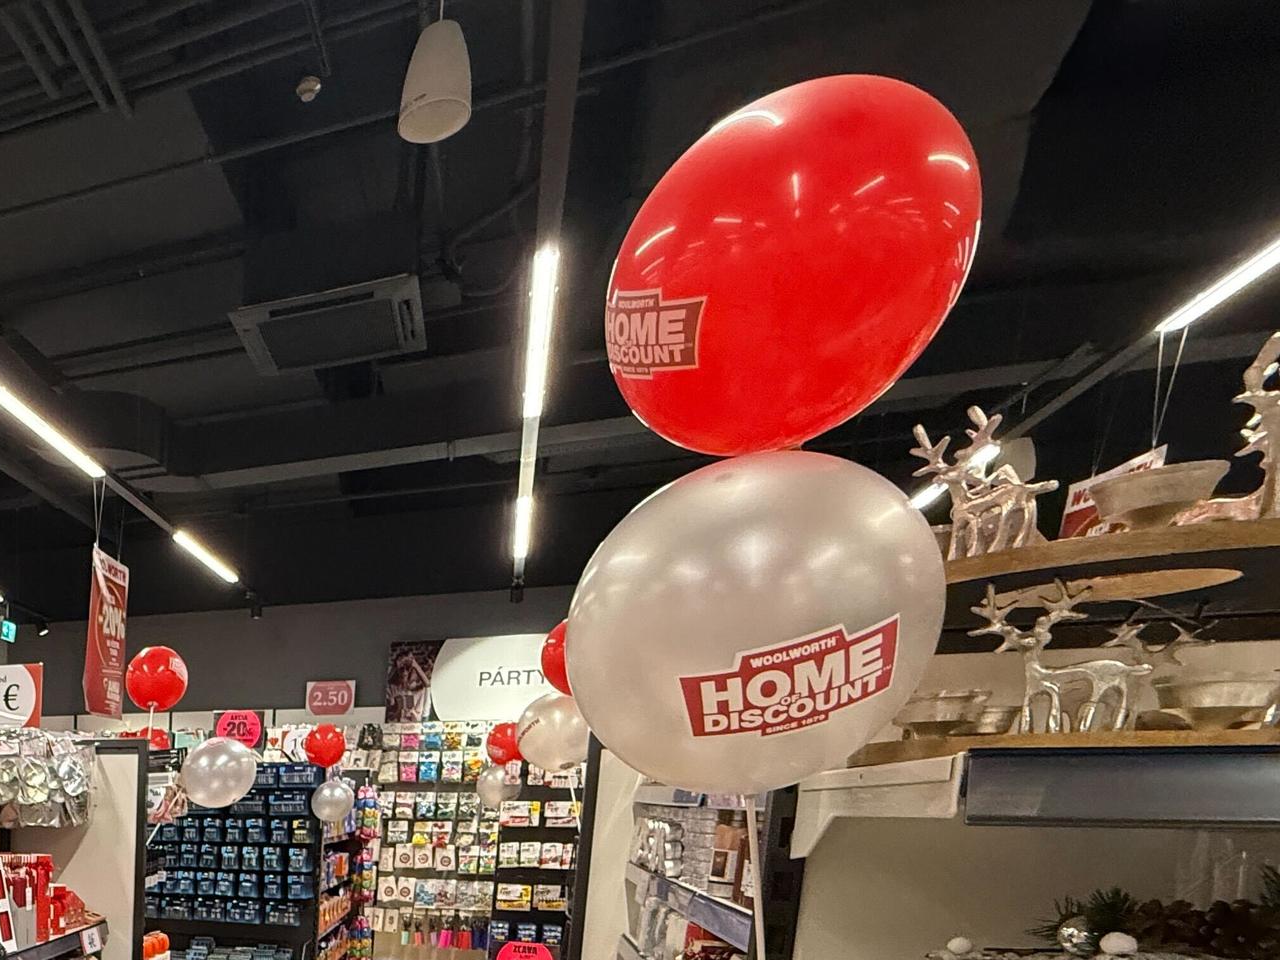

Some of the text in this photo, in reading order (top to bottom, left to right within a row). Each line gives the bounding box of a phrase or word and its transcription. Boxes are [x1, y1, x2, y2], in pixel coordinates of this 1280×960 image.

[607, 309, 686, 346] HOME
[750, 635, 837, 669] WOOLWORTH
[700, 633, 883, 714] HOME
[312, 690, 348, 706] 2.50
[704, 671, 883, 733] DISCOUNT
[781, 693, 800, 705] OF
[765, 721, 798, 734] SINCE
